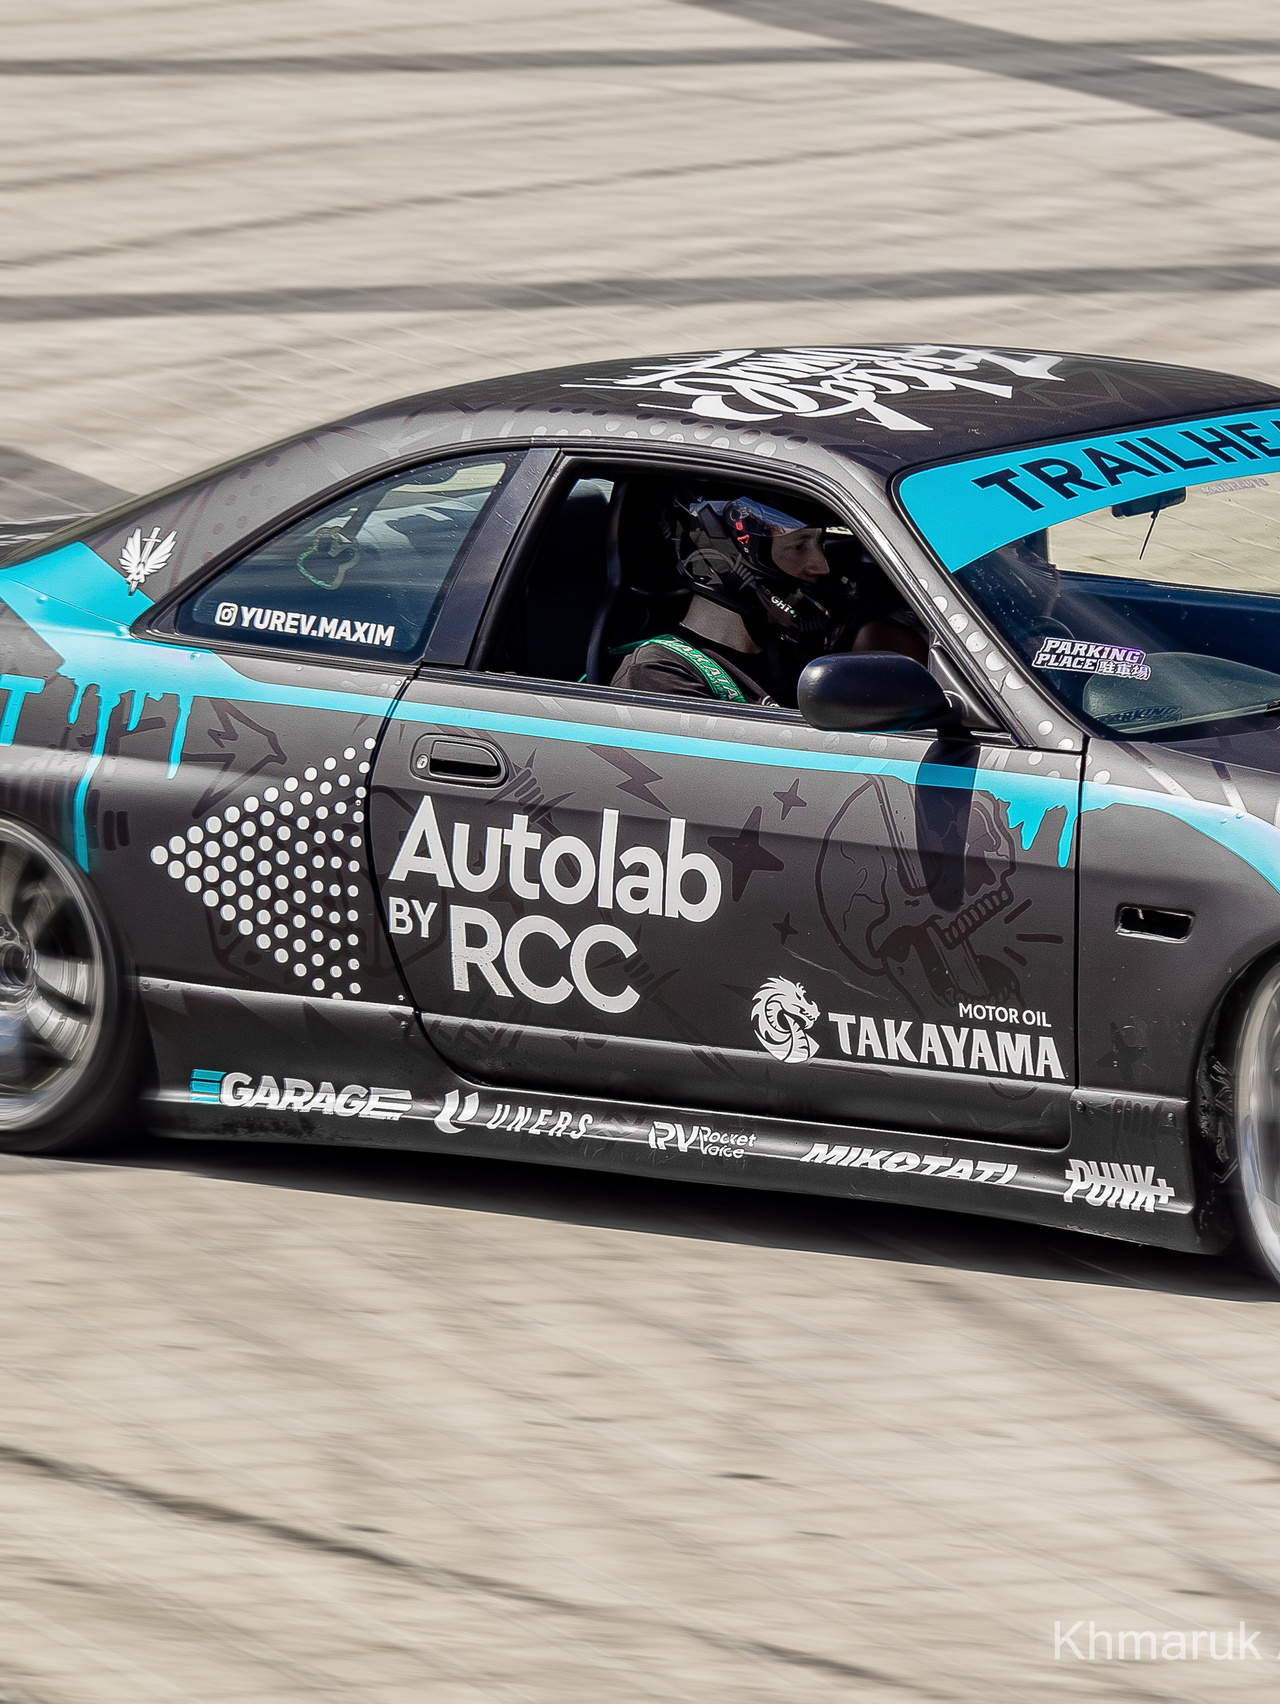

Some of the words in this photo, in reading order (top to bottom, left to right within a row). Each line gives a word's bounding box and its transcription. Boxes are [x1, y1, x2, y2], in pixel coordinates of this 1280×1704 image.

[240, 605, 395, 648] YUREV.MAXIM
[1035, 652, 1097, 671] PLACE
[1043, 639, 1144, 664] PARKING
[388, 795, 722, 923] Autolab
[388, 896, 438, 938] BY
[449, 904, 642, 1014] RCC
[958, 1002, 1020, 1025] MOTOR
[1021, 1008, 1052, 1028] OIL
[827, 1012, 1066, 1080] TAKAYAMA
[220, 1071, 413, 1121] GARAGE
[800, 1142, 1020, 1186] MIKOTATI
